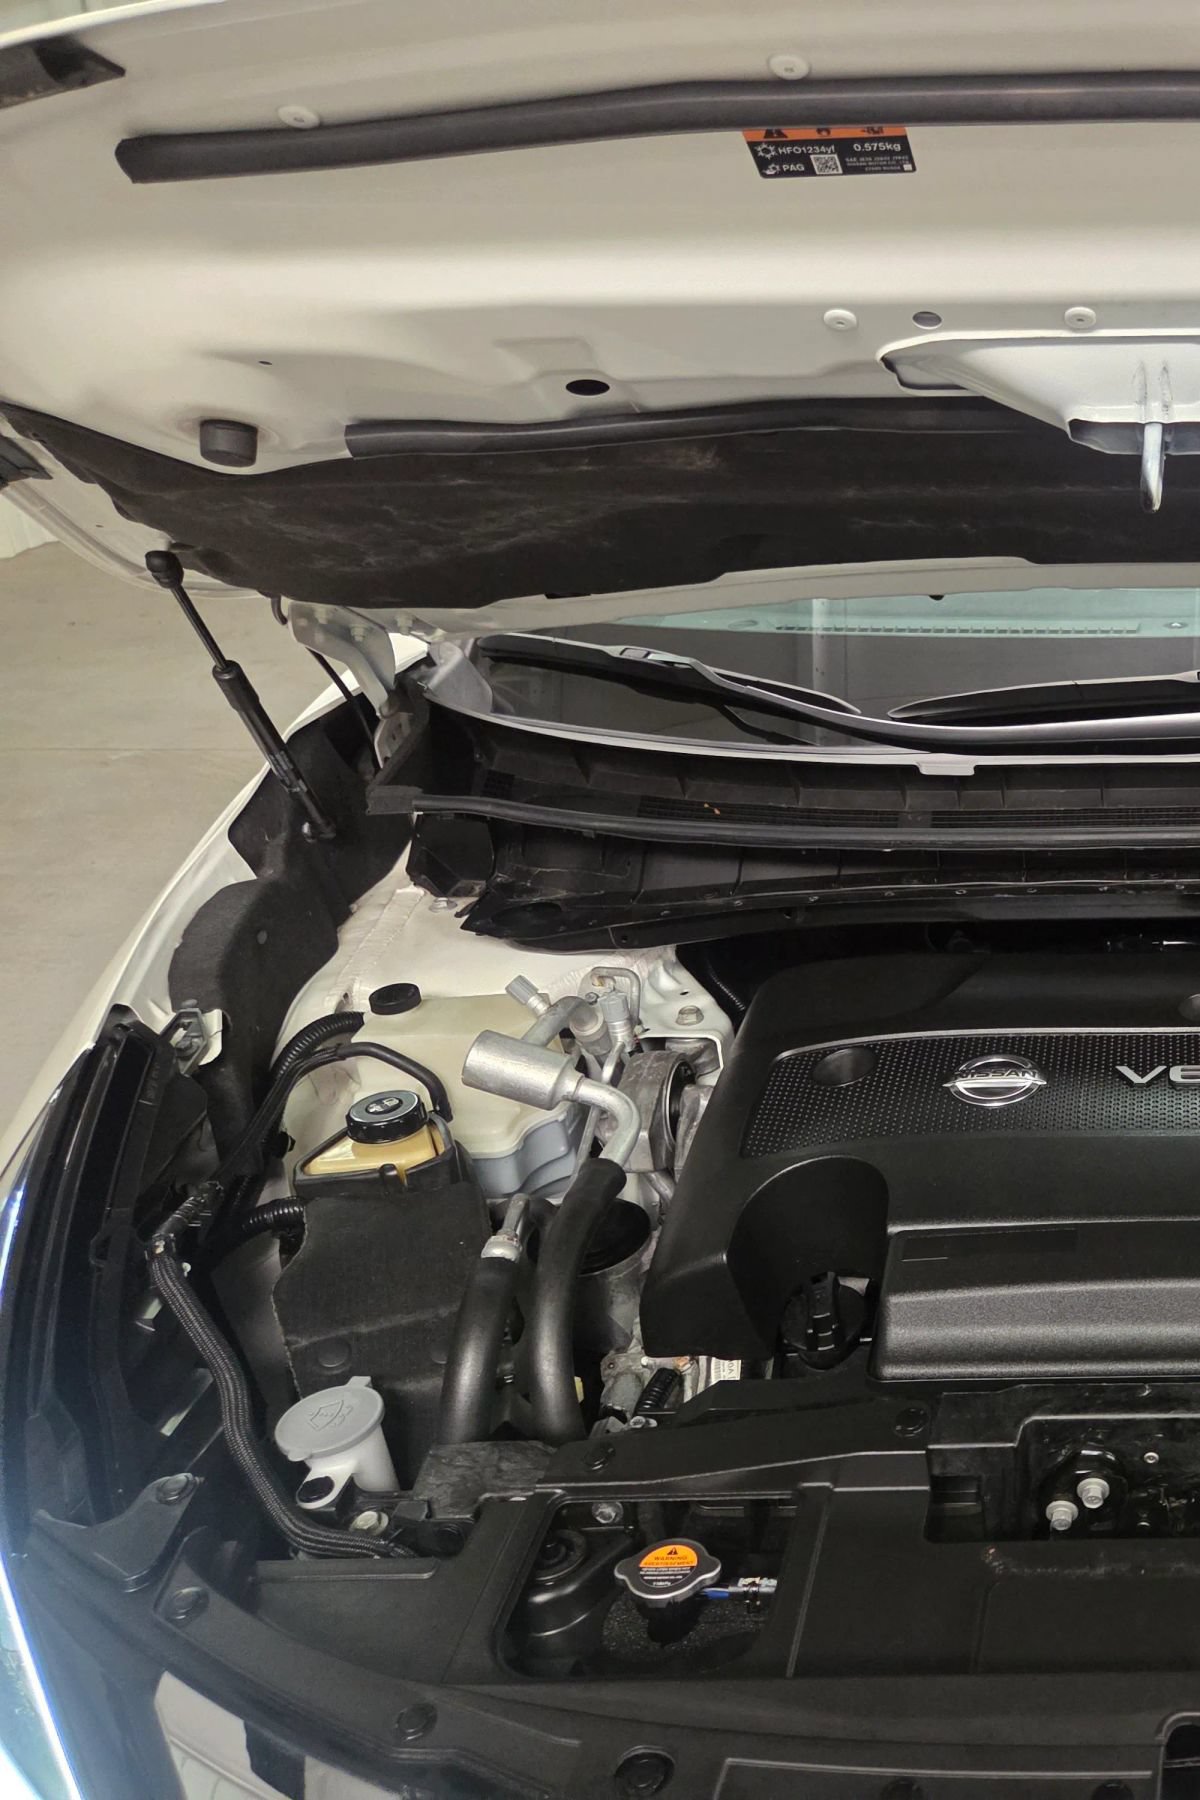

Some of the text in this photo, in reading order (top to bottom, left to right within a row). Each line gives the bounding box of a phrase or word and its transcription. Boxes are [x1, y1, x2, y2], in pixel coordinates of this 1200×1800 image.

[853, 142, 902, 151] 0.575kg
[782, 163, 805, 171] PAG
[954, 1068, 1038, 1079] NISSAN
